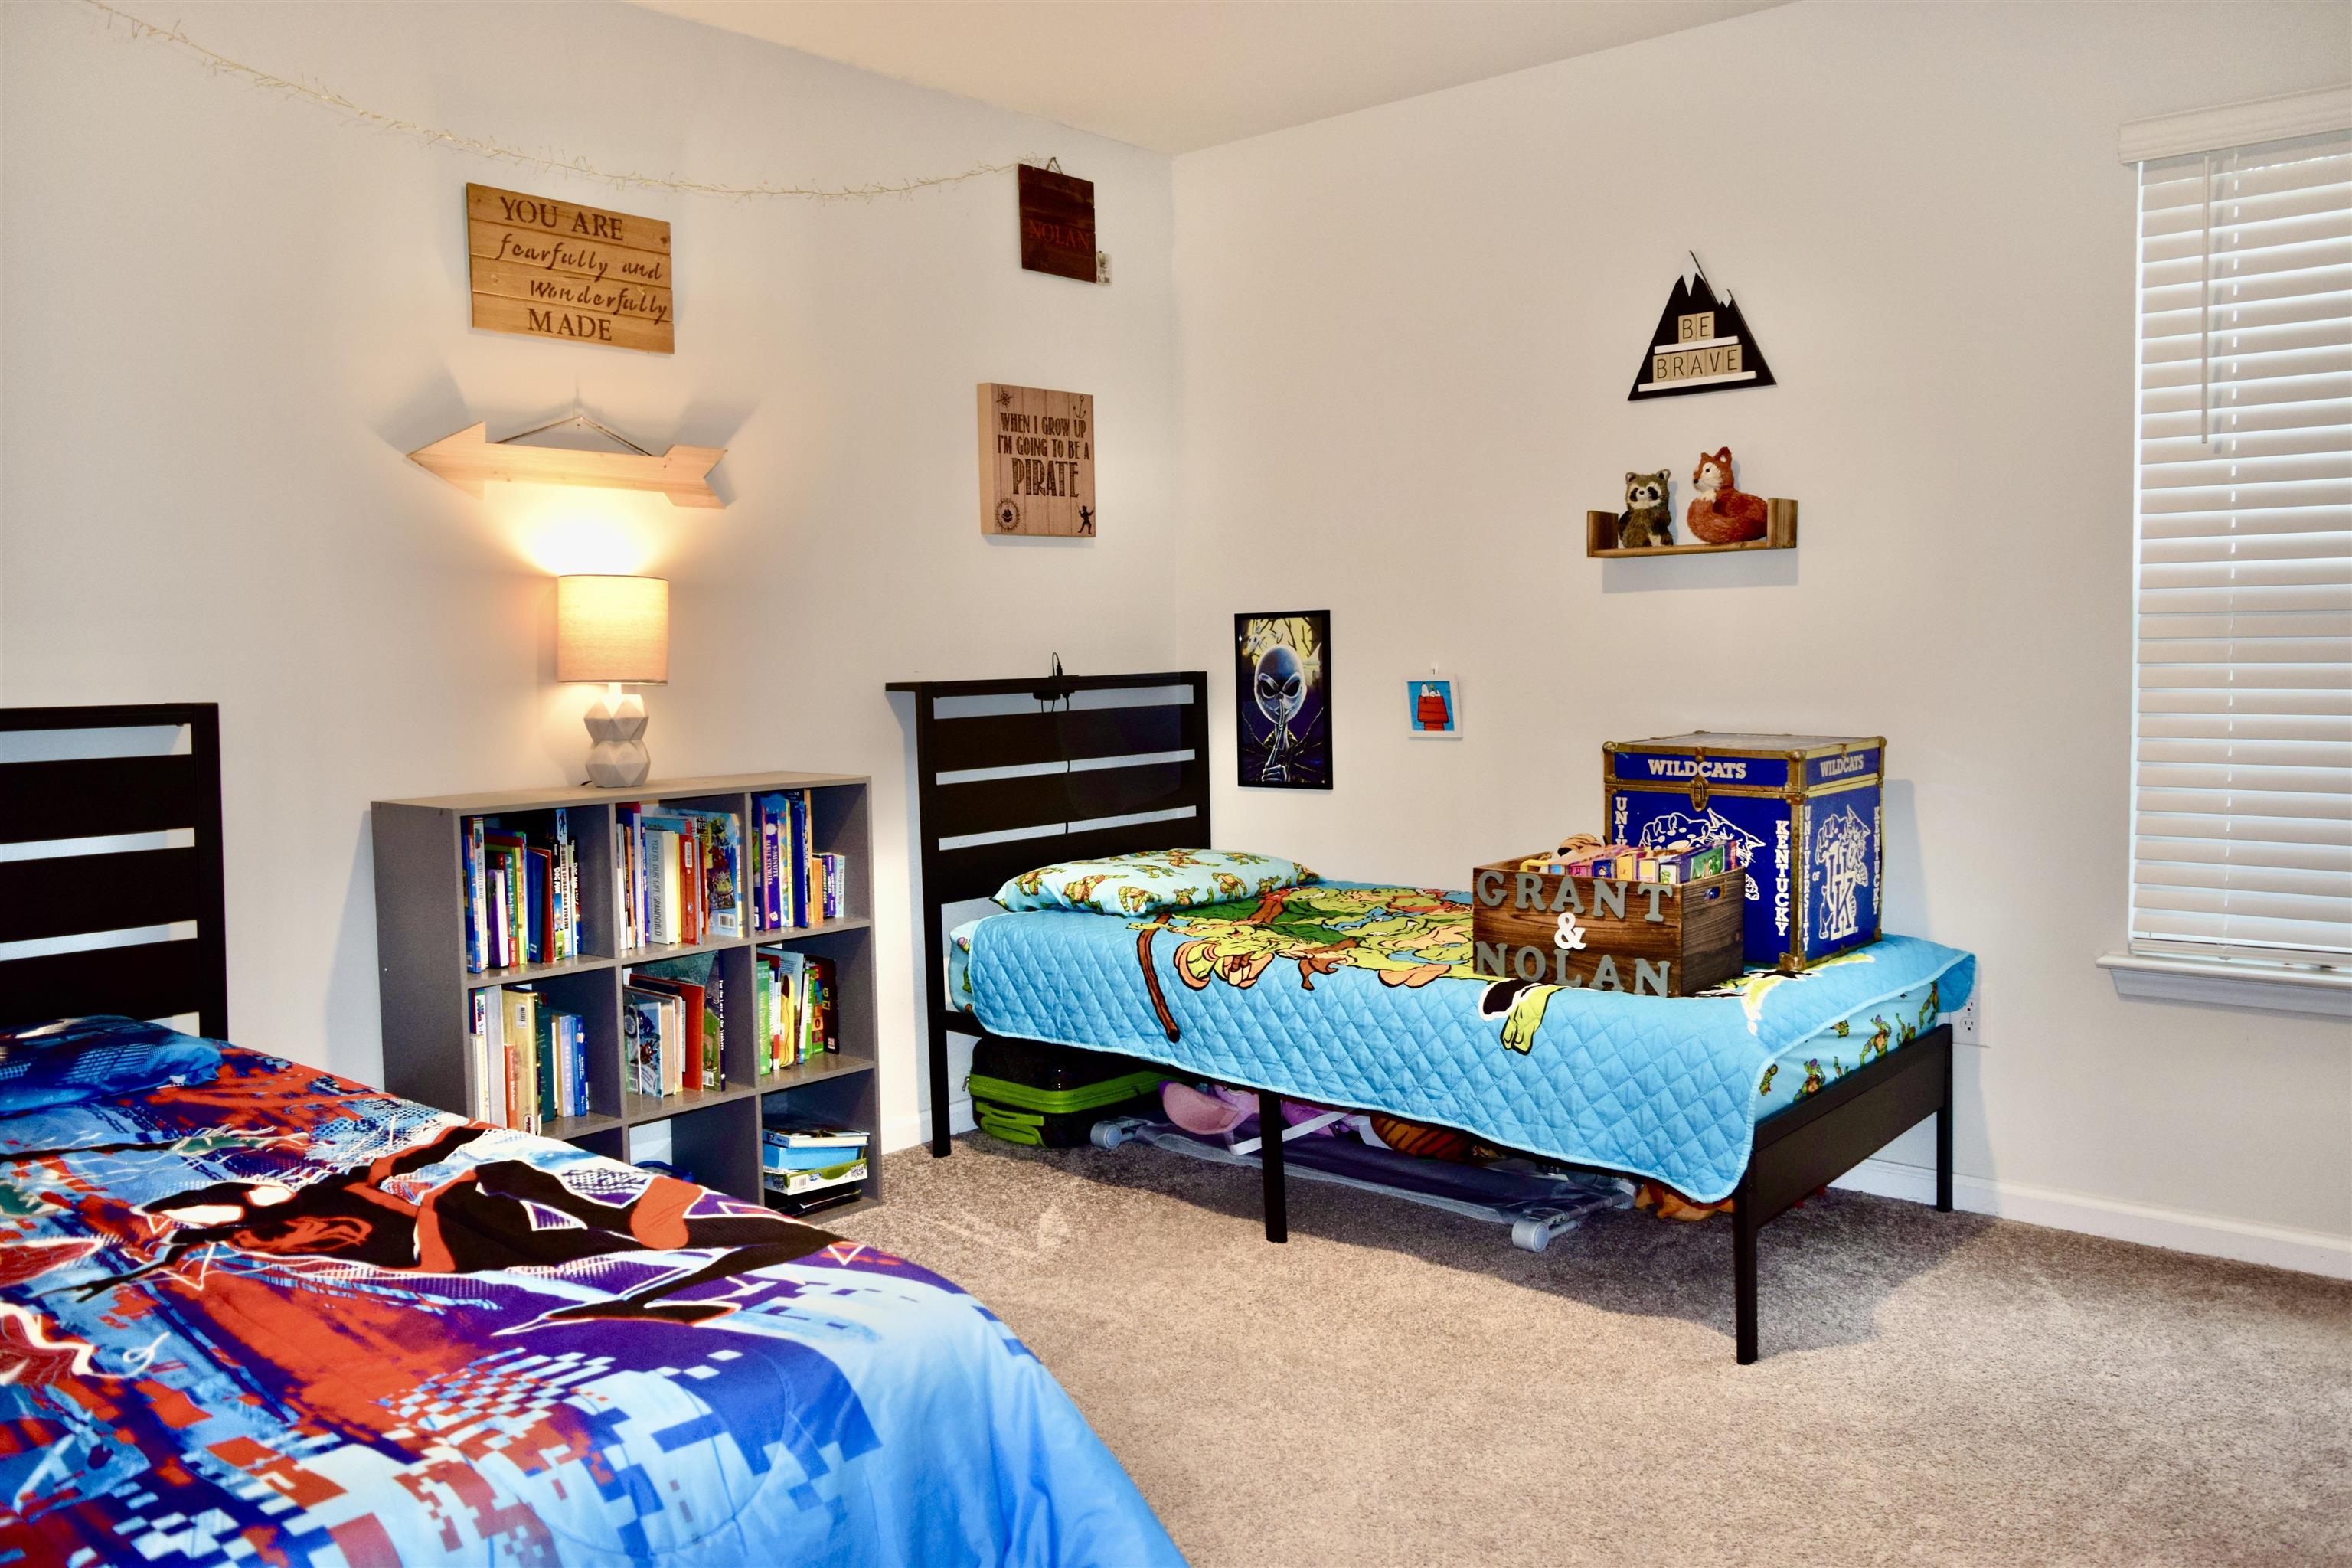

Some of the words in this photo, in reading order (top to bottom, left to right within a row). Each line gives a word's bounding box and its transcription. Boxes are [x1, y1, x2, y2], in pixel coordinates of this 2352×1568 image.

[499, 196, 557, 228] YOU
[571, 211, 624, 241] ARE
[1028, 219, 1089, 250] NOLAN
[495, 233, 608, 283] fearfully
[622, 262, 662, 280] and
[527, 308, 612, 341] MADE
[1682, 315, 1710, 340] BE
[1657, 349, 1738, 379] BRAVE
[1000, 412, 1030, 433] WHEN
[1034, 415, 1037, 434] I
[1042, 416, 1070, 436] GROW
[1073, 420, 1086, 438] UP
[998, 434, 1012, 455] I'M
[1016, 436, 1047, 457] GOING
[1052, 439, 1064, 459] TO
[1068, 440, 1080, 459] BE
[1084, 442, 1090, 460] A
[1011, 457, 1080, 498] PIRATE
[1648, 759, 1746, 779] WILDCATS
[1820, 754, 1864, 778] WILDCATS
[651, 839, 660, 863] YOU'RE
[652, 864, 661, 878] OUR
[1775, 819, 1790, 936] KENTUCKY
[1803, 805, 1811, 952] UNIVERSITY
[1812, 871, 1820, 882] OF
[1476, 870, 1673, 923] GRANT
[653, 895, 662, 936] GRANDCHILD
[1553, 911, 1587, 950] &
[1475, 940, 1671, 998] NOLAN
